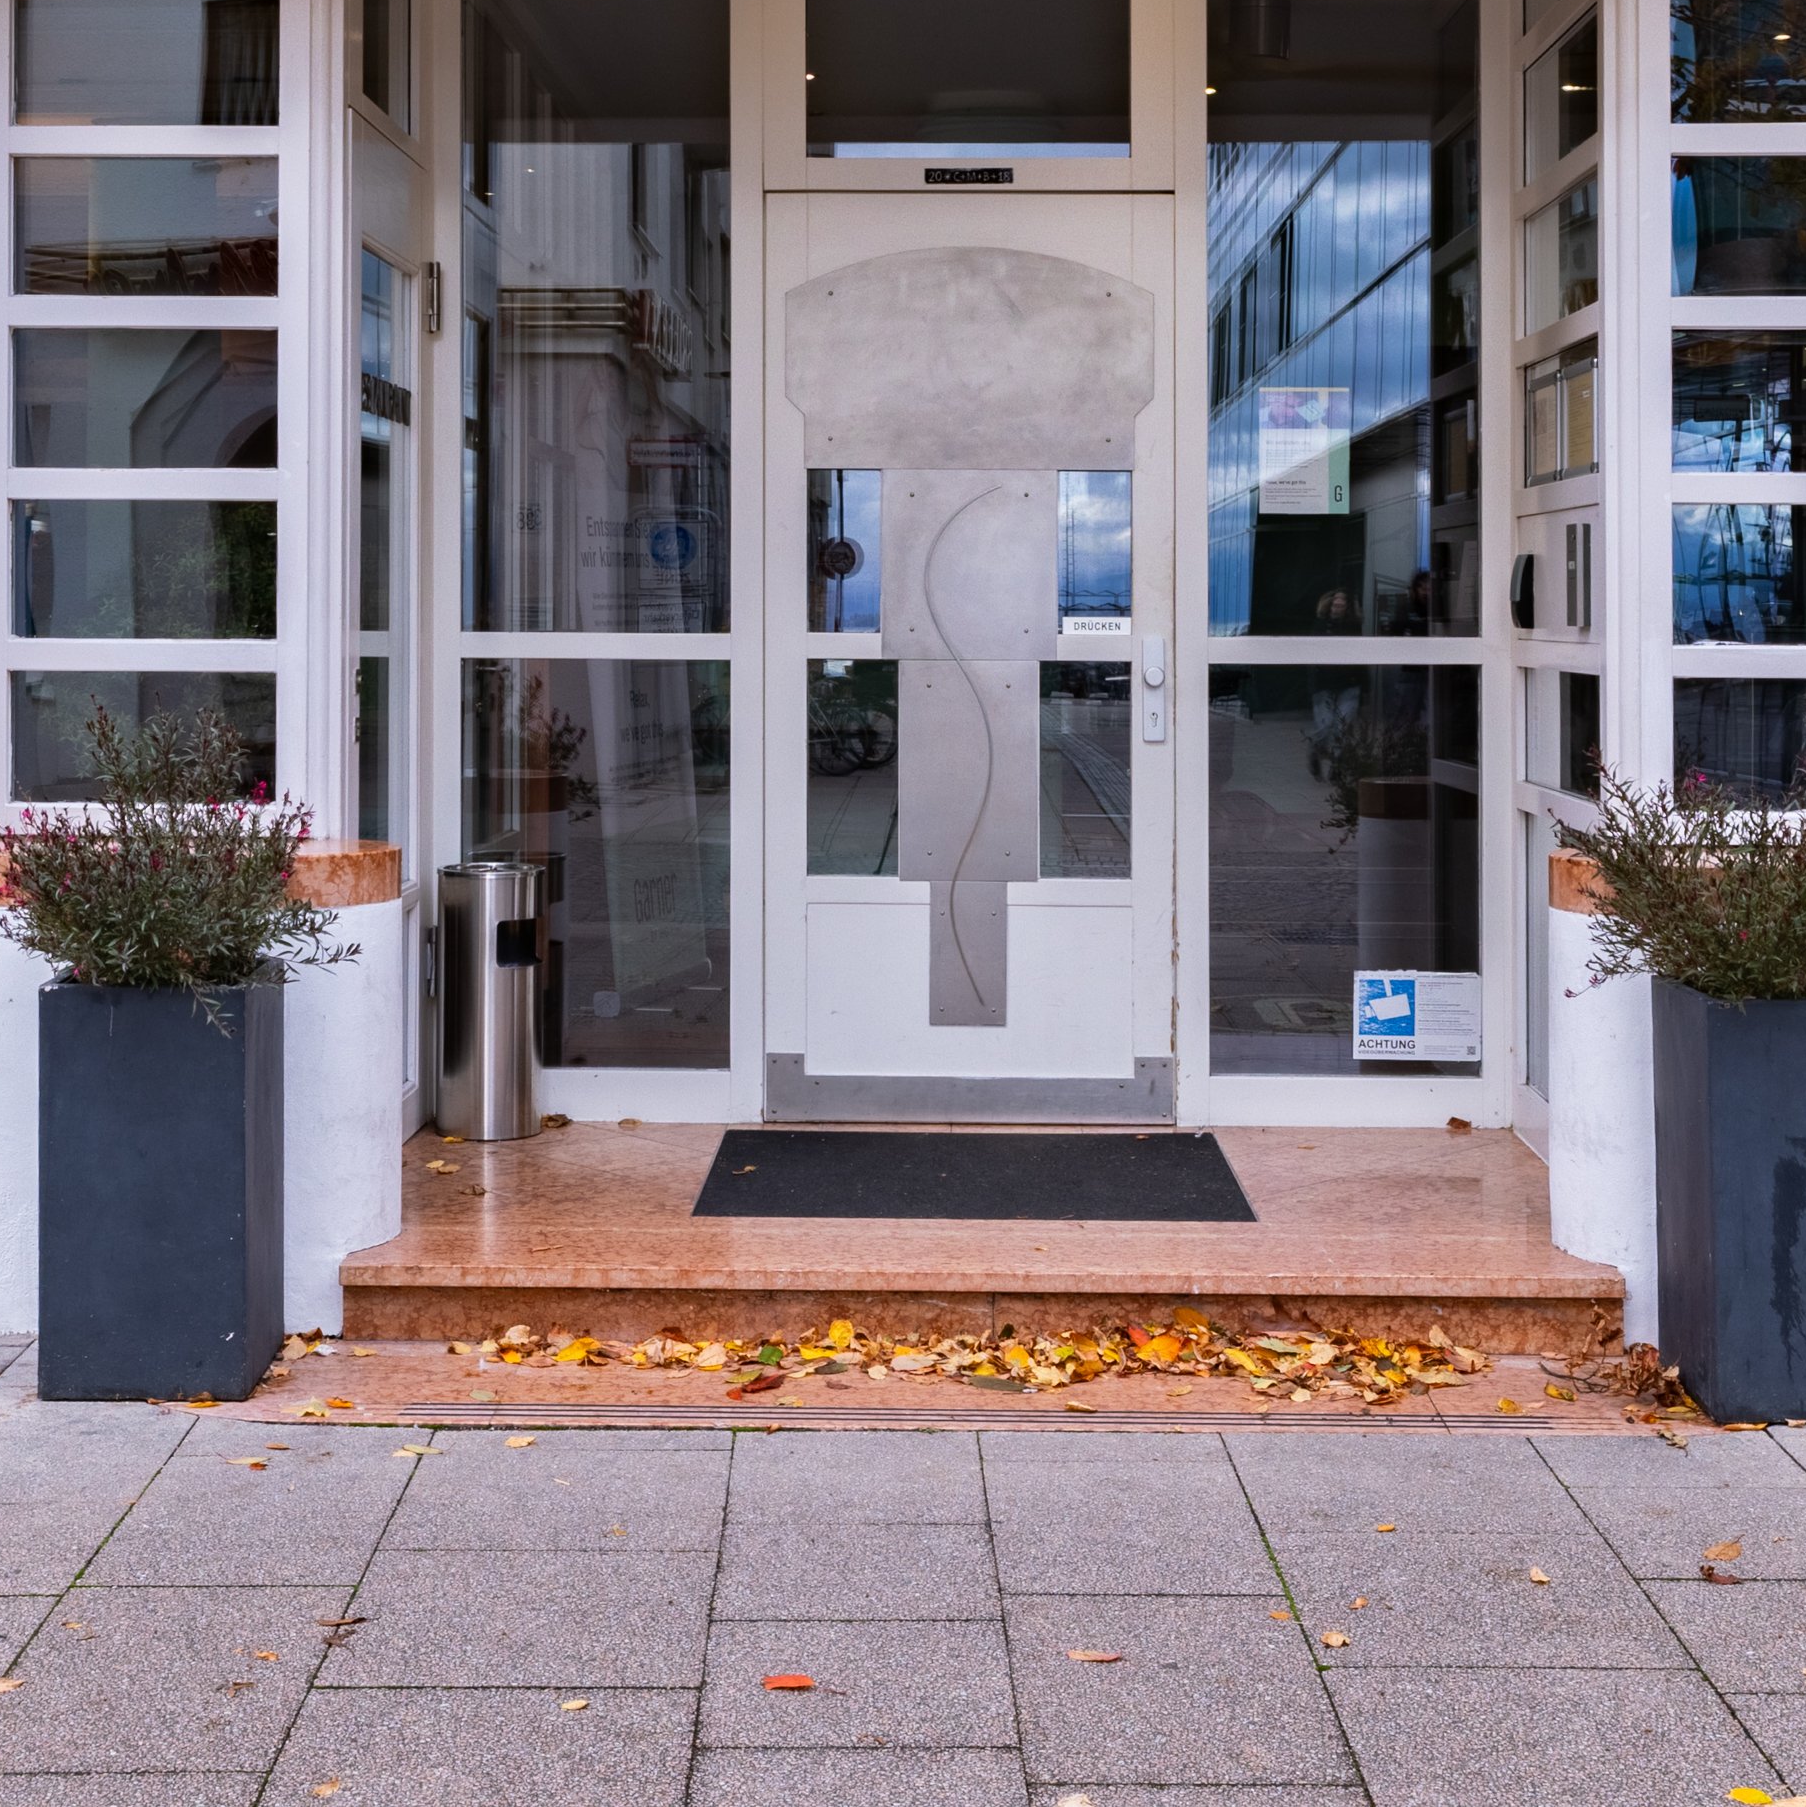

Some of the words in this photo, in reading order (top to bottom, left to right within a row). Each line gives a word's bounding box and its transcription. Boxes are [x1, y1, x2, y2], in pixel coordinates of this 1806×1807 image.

[1334, 485, 1343, 503] G
[1074, 619, 1121, 630] DRÜCKEN
[634, 873, 677, 924] Garner
[1358, 1039, 1416, 1049] ACHTUNG
